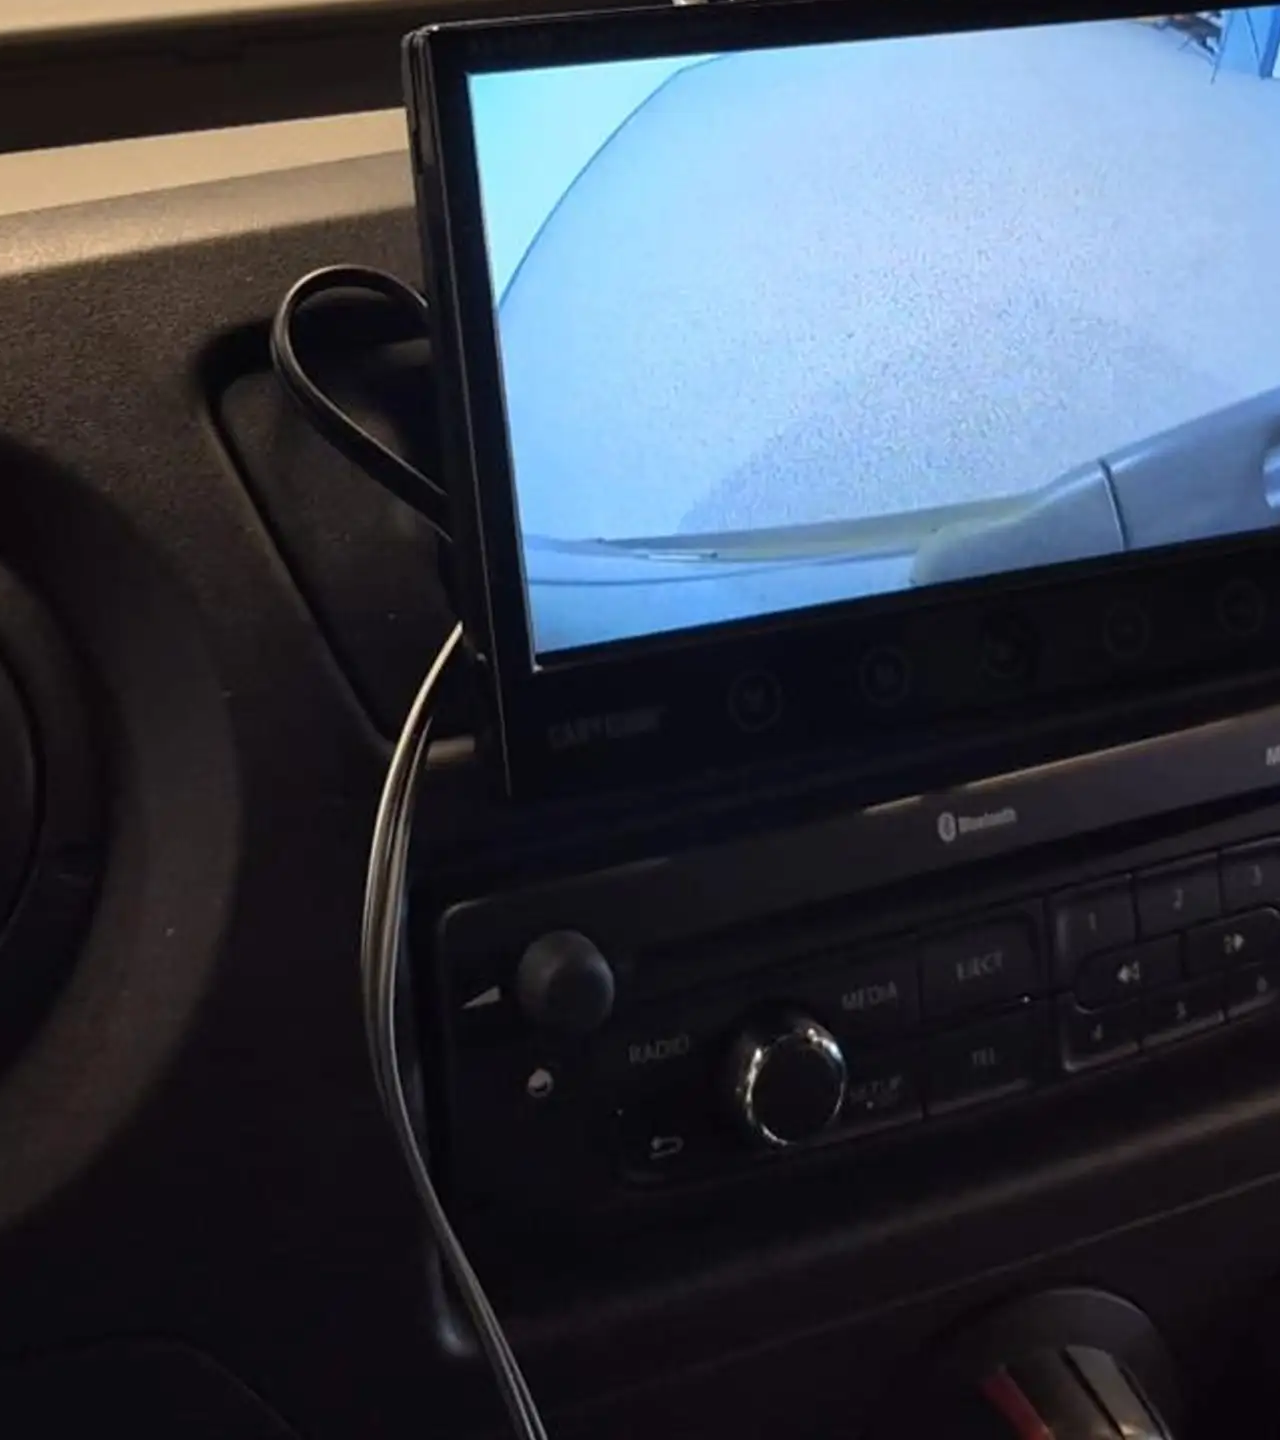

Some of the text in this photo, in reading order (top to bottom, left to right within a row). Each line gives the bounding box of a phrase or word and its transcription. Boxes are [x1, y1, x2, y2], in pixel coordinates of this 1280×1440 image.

[958, 807, 1017, 833] Bluetooth
[841, 981, 898, 1012] MEDIA
[628, 1034, 690, 1064] RADIO
